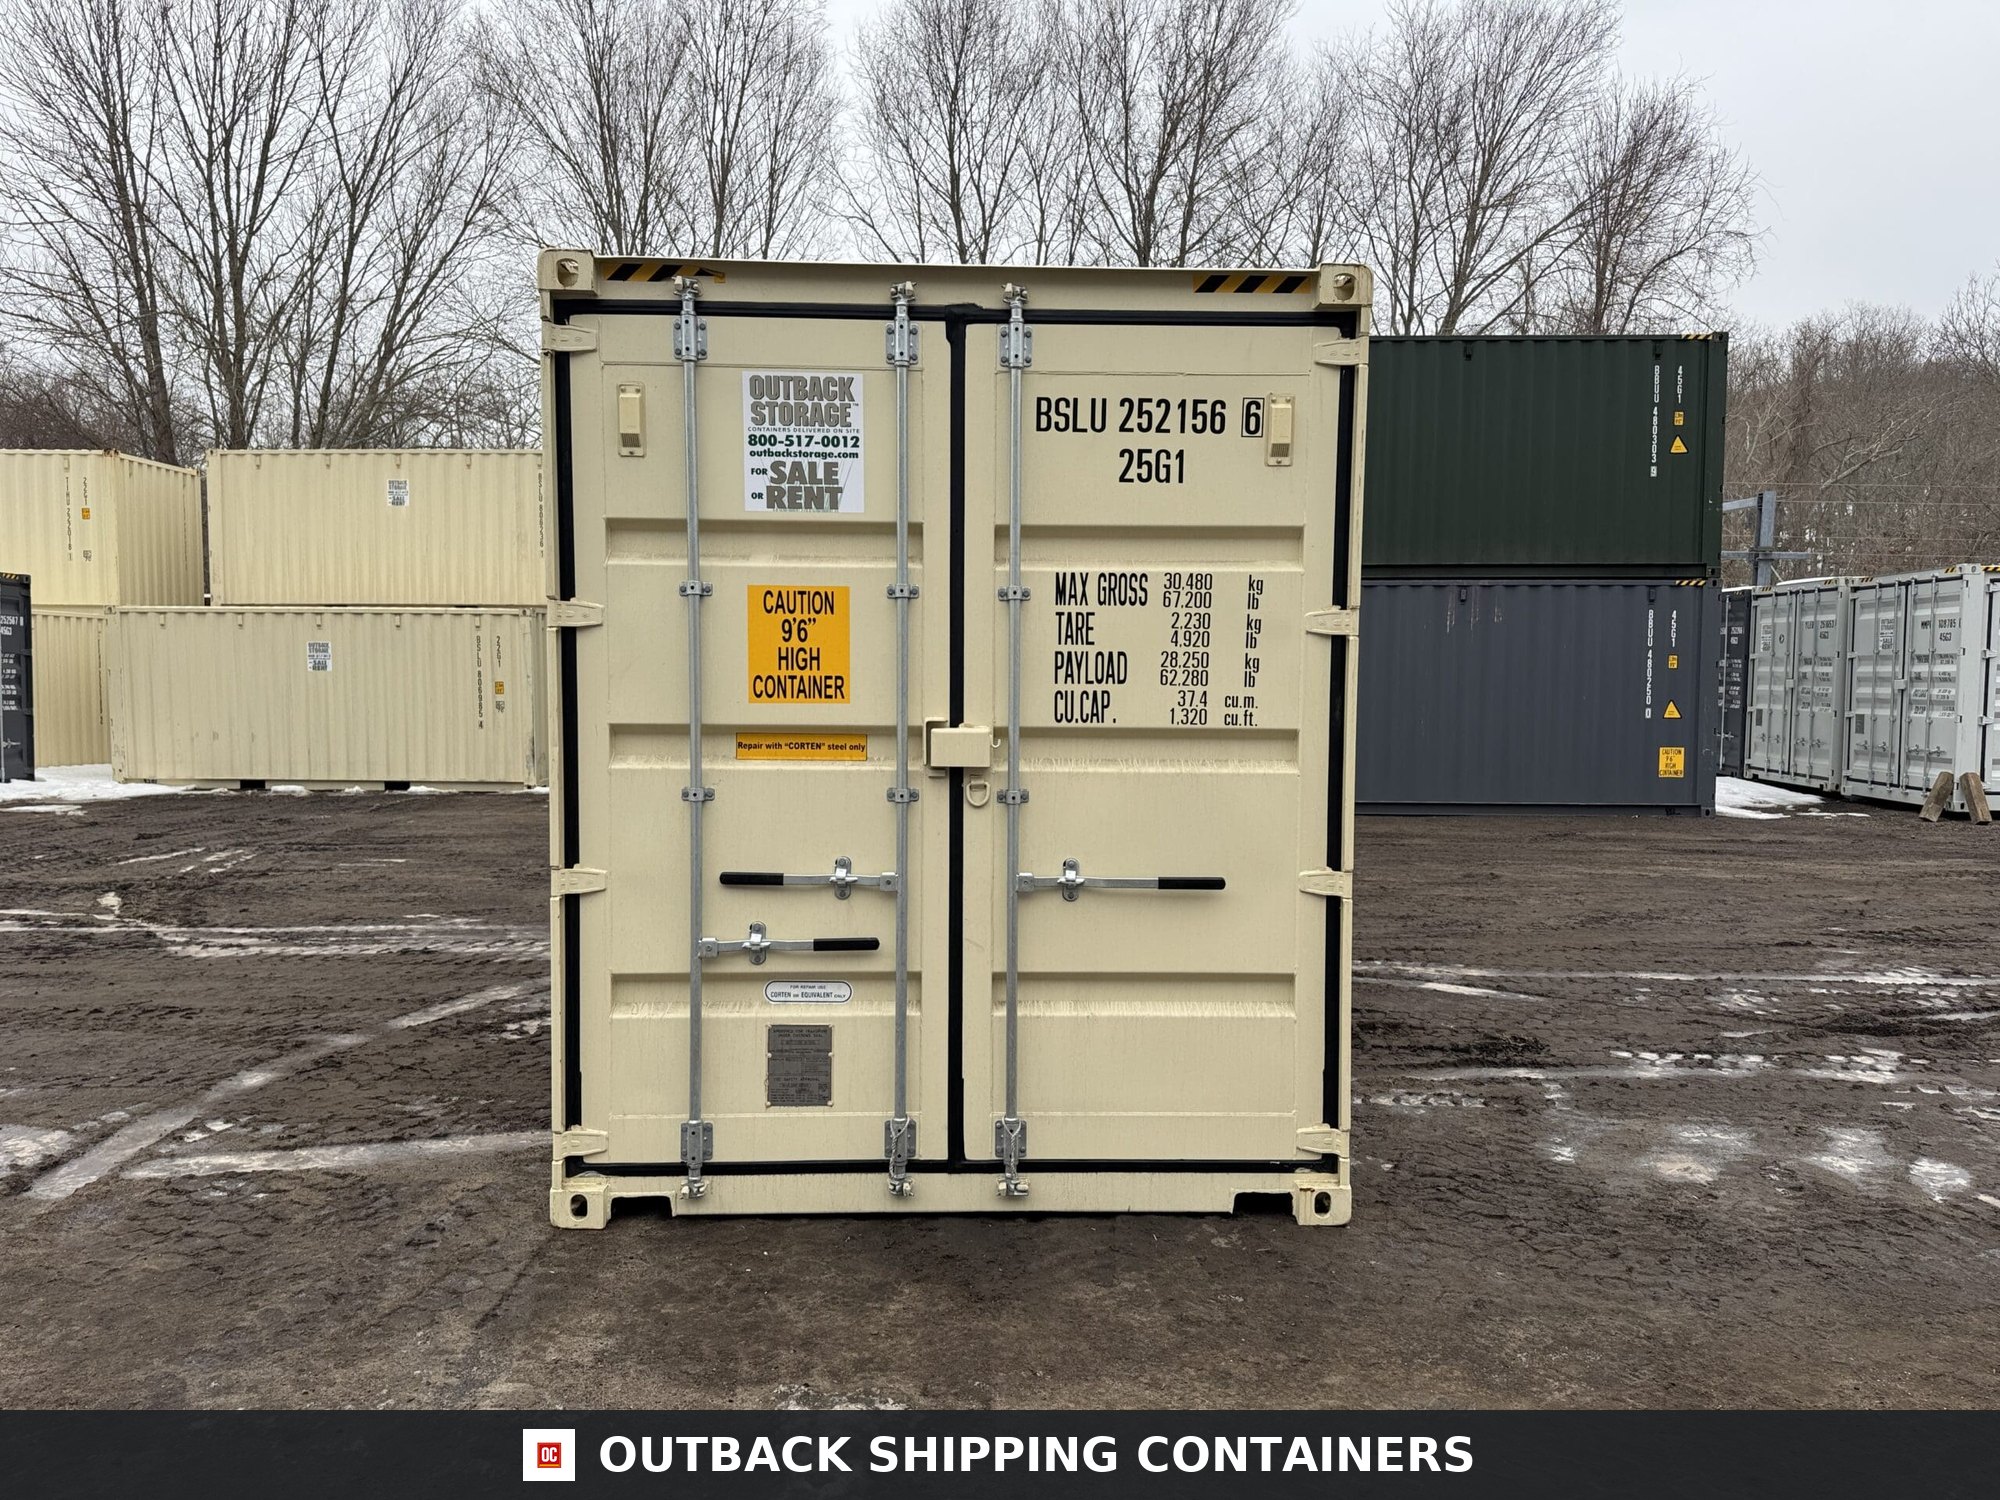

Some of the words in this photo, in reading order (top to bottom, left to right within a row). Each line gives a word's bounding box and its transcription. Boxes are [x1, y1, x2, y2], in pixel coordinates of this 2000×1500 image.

[749, 375, 855, 402] OUTBACK
[750, 401, 852, 428] STORAGE
[1036, 397, 1107, 433] BSLU
[1118, 398, 1226, 434] 252156
[1244, 400, 1262, 435] 6
[748, 434, 860, 448] 800-517-0012
[749, 448, 859, 460] outbackstorage.com
[1118, 449, 1184, 484] 25G1
[751, 468, 768, 476] FOR
[770, 460, 839, 486] SALE
[751, 492, 764, 500] OR
[766, 485, 843, 510] RENT
[1055, 572, 1089, 606] MAX
[1097, 572, 1149, 607] GROSS
[1248, 574, 1264, 596] kg
[1247, 592, 1259, 610] lb
[763, 590, 835, 615] CAUTION
[1055, 611, 1095, 645] TARE
[1246, 613, 1262, 635] kg
[1245, 632, 1257, 649] lb
[778, 646, 821, 671] HIGH
[1054, 650, 1128, 685] PAYLOAD
[1244, 652, 1260, 674] kg
[753, 674, 845, 700] CONTAINER
[1243, 670, 1255, 688] lb
[1177, 689, 1208, 708] 37.4
[1224, 695, 1259, 709] cu.m.
[1224, 709, 1258, 727] cu.ft.
[737, 741, 763, 751] Repair
[765, 742, 783, 750] with
[827, 743, 847, 751] steel
[849, 743, 866, 753] only
